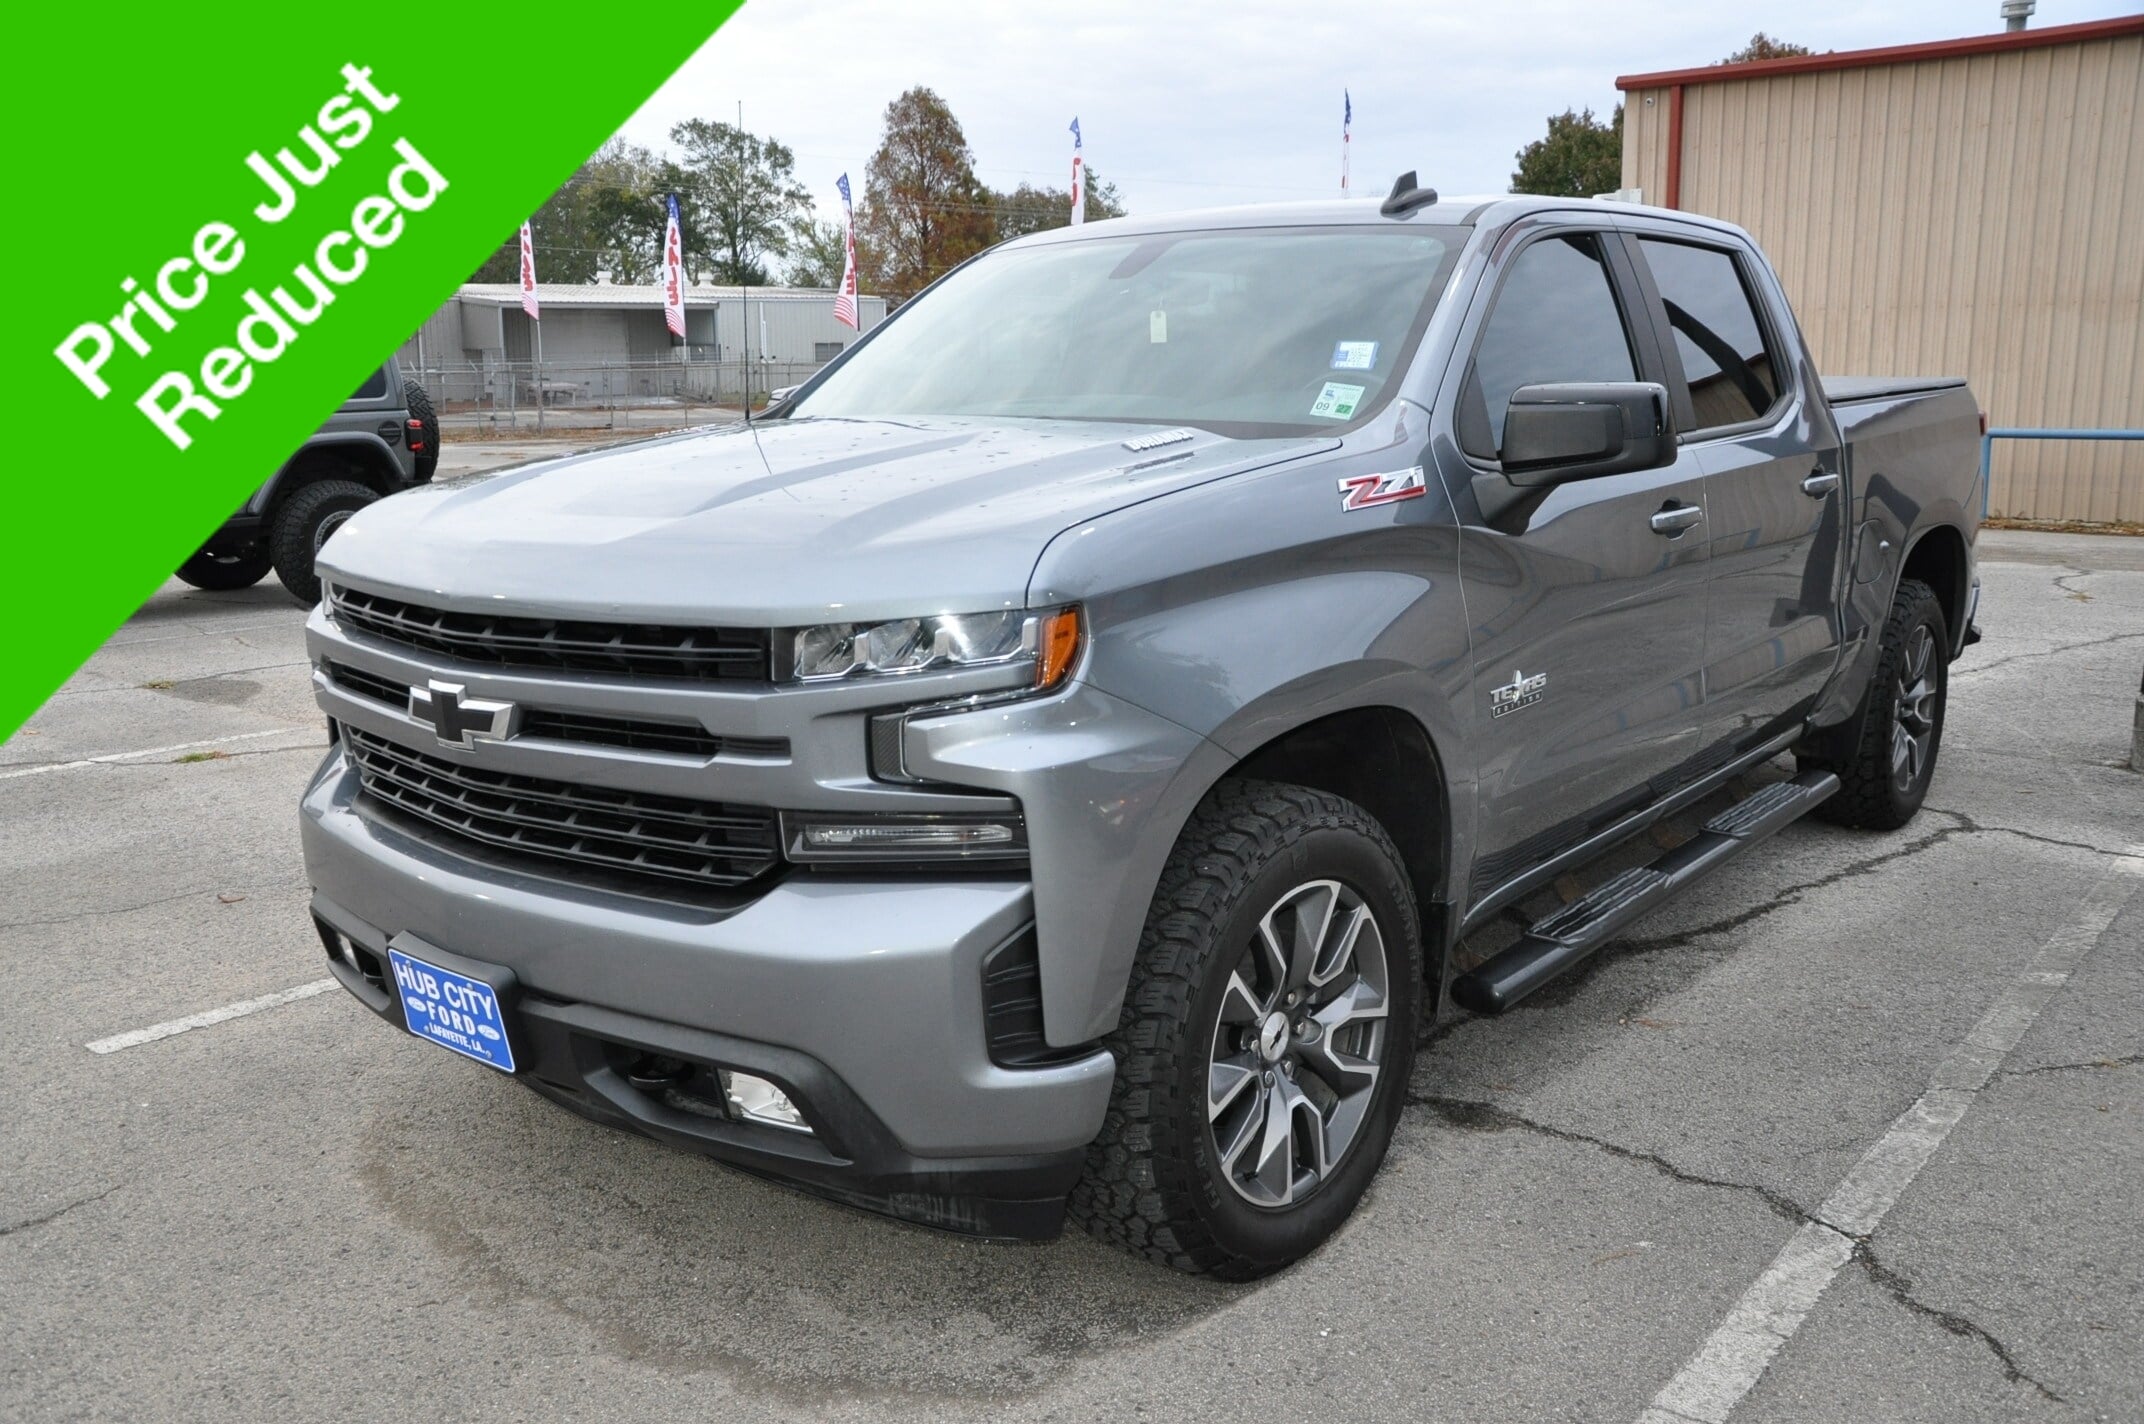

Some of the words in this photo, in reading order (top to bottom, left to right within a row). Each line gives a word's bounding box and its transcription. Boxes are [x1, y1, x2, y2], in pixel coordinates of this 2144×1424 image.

[1316, 402, 1330, 411] 09
[1338, 466, 1427, 513] Z71
[394, 961, 441, 1000] HUB
[443, 981, 493, 1020] CITY
[426, 1000, 476, 1036] FORD
